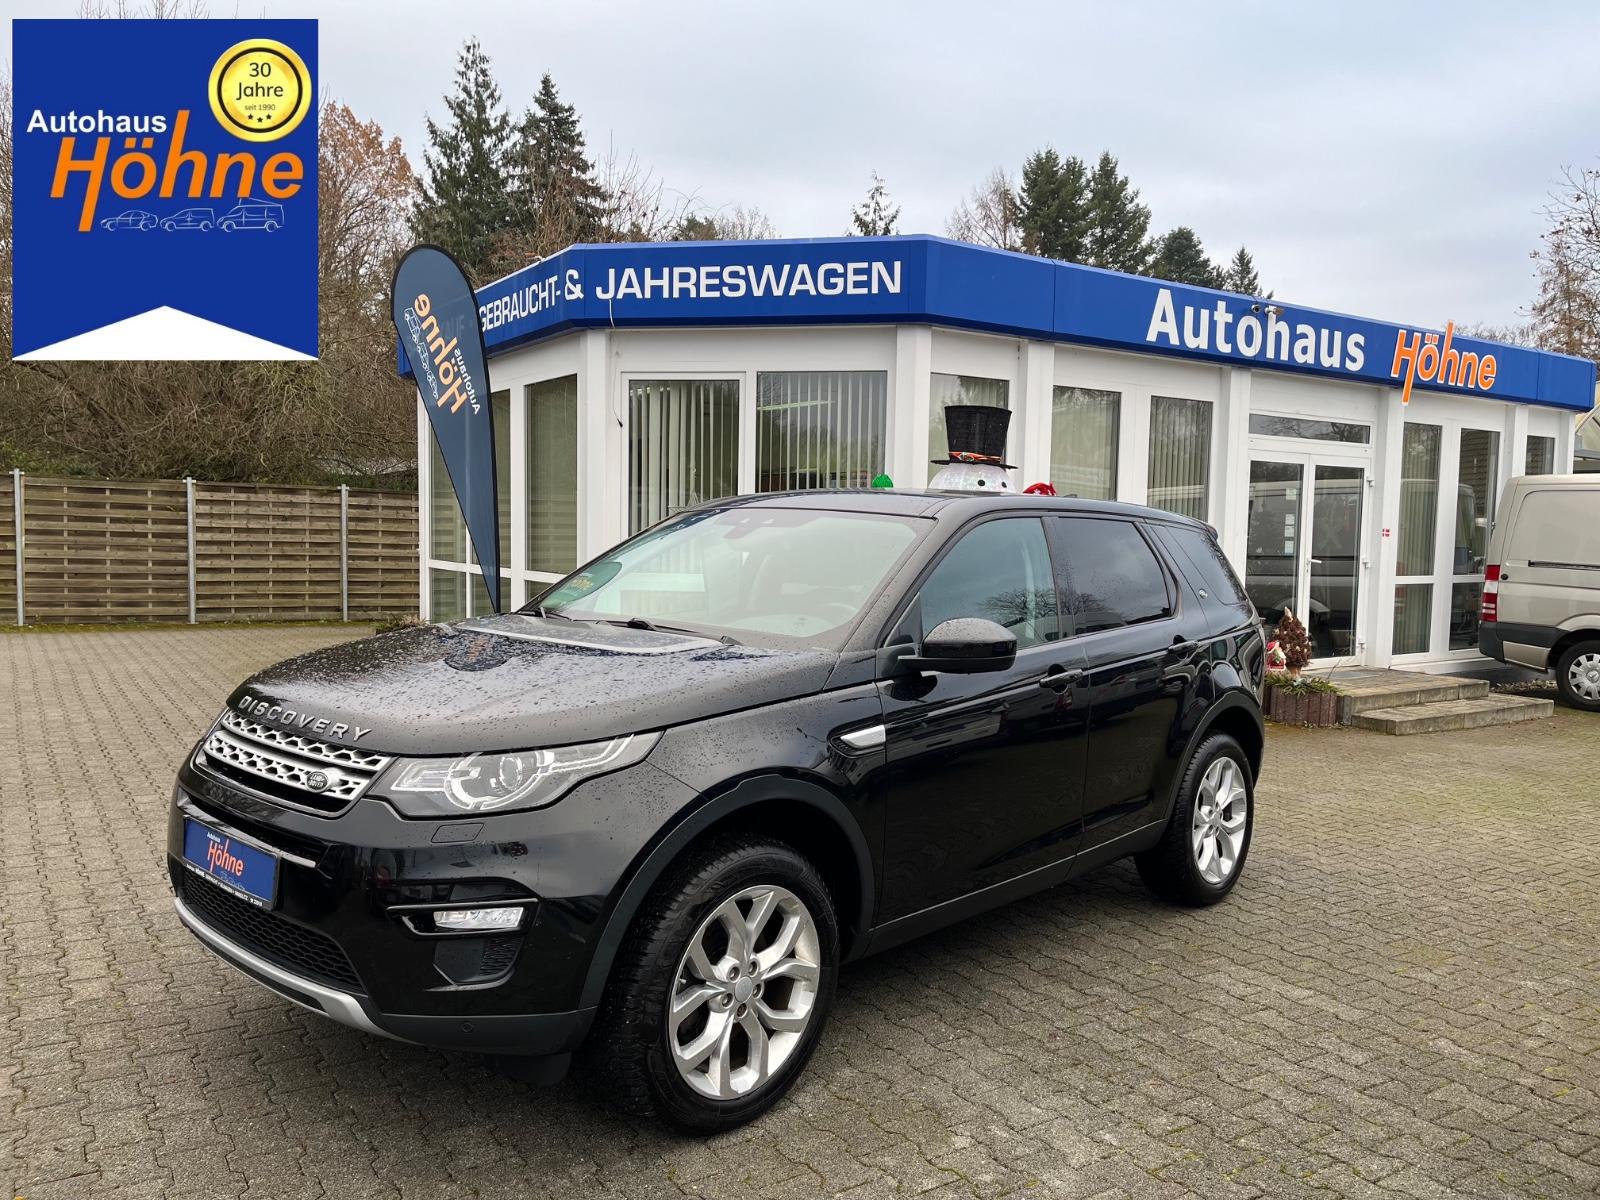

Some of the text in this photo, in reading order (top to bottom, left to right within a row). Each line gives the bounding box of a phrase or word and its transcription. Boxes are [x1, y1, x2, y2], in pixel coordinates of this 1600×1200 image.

[565, 269, 585, 300] &
[595, 260, 901, 300] JAHRESWAGEN
[1146, 288, 1497, 406] Autohaus Höhne
[238, 695, 372, 742] DISCOVERY
[207, 838, 244, 877] Höhne
